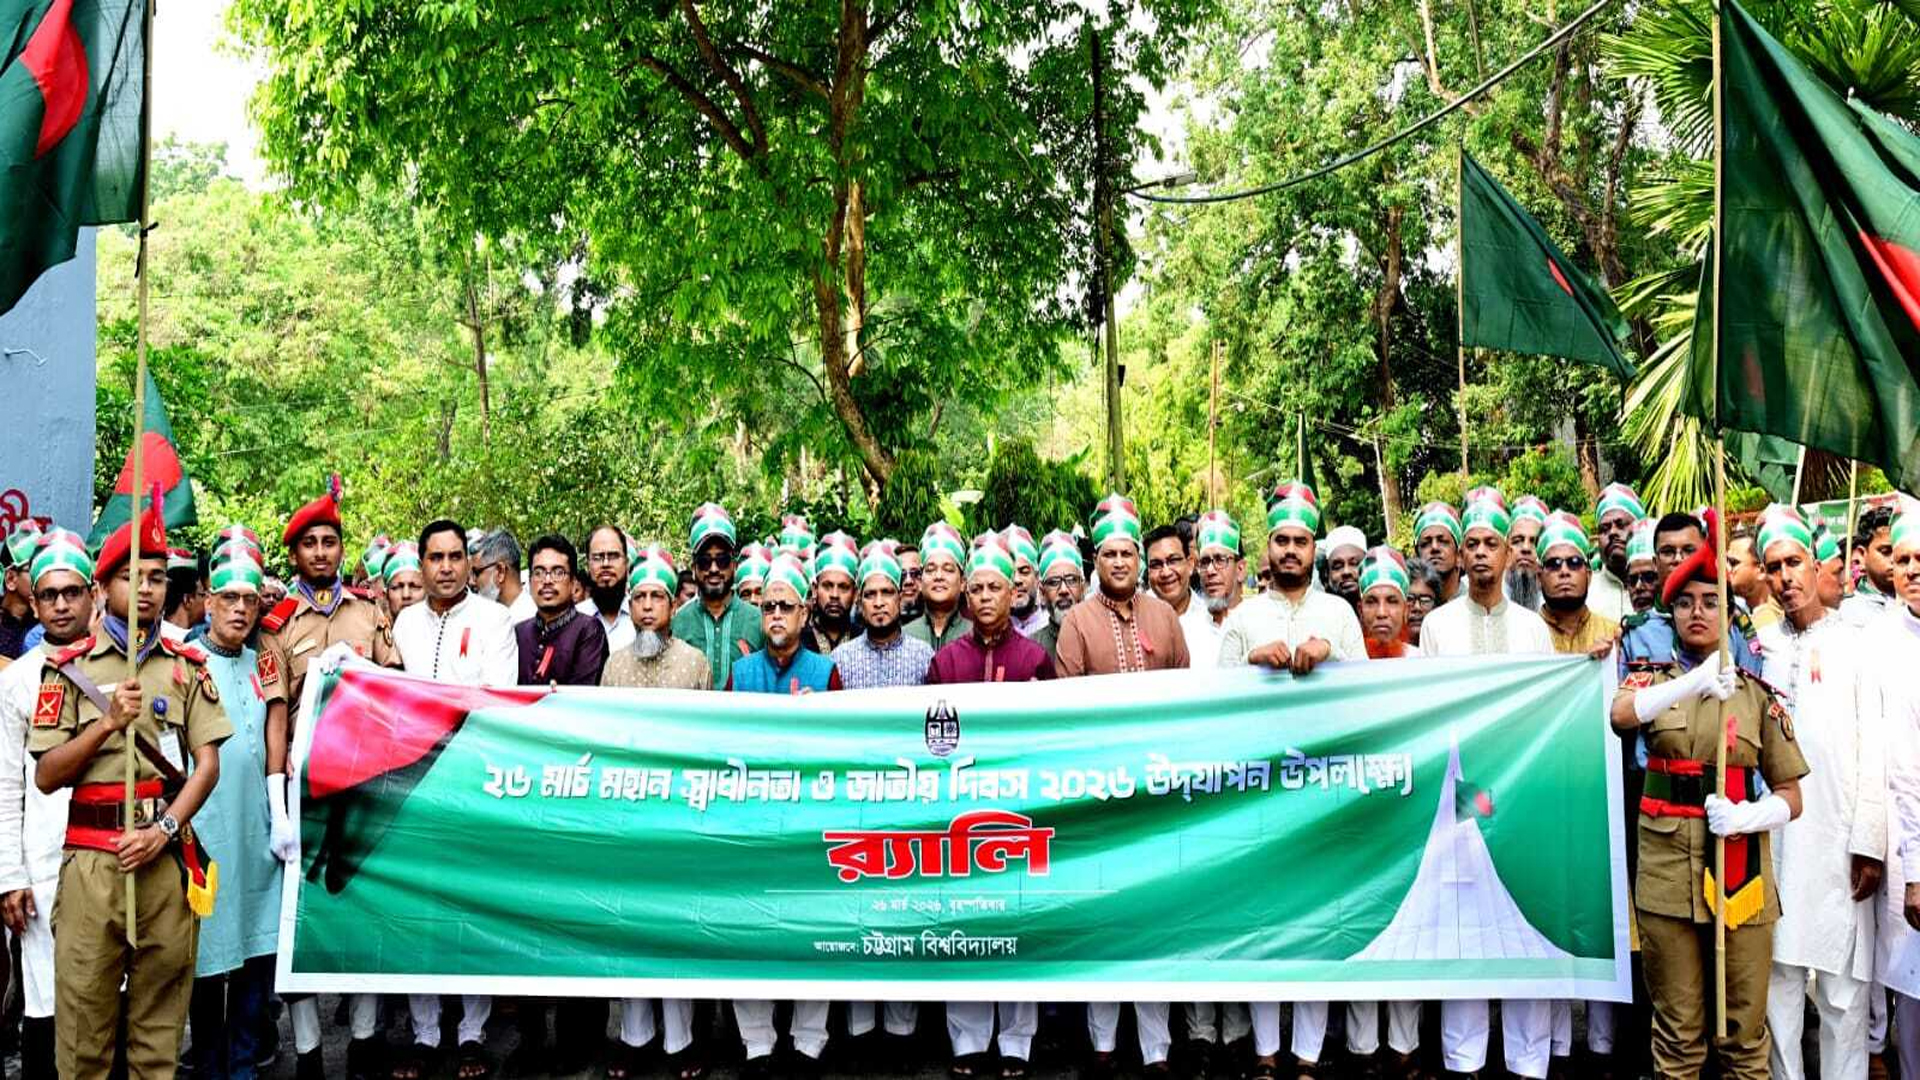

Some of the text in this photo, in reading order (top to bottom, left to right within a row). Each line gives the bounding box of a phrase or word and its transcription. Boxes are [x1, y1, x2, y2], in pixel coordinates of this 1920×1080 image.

[483, 763, 533, 798] ২৬
[540, 752, 594, 799] মার্চ
[599, 766, 674, 802] মহান
[681, 757, 801, 812] স্বাধীনতা
[811, 770, 836, 801] ও
[846, 757, 941, 803] জাতীয়
[950, 755, 1029, 802] দিবস
[1040, 764, 1137, 802] ২০২৬
[862, 930, 915, 956] চট্টগ্রাম
[920, 929, 1018, 956] বিশ্ববিদ্যালয়
